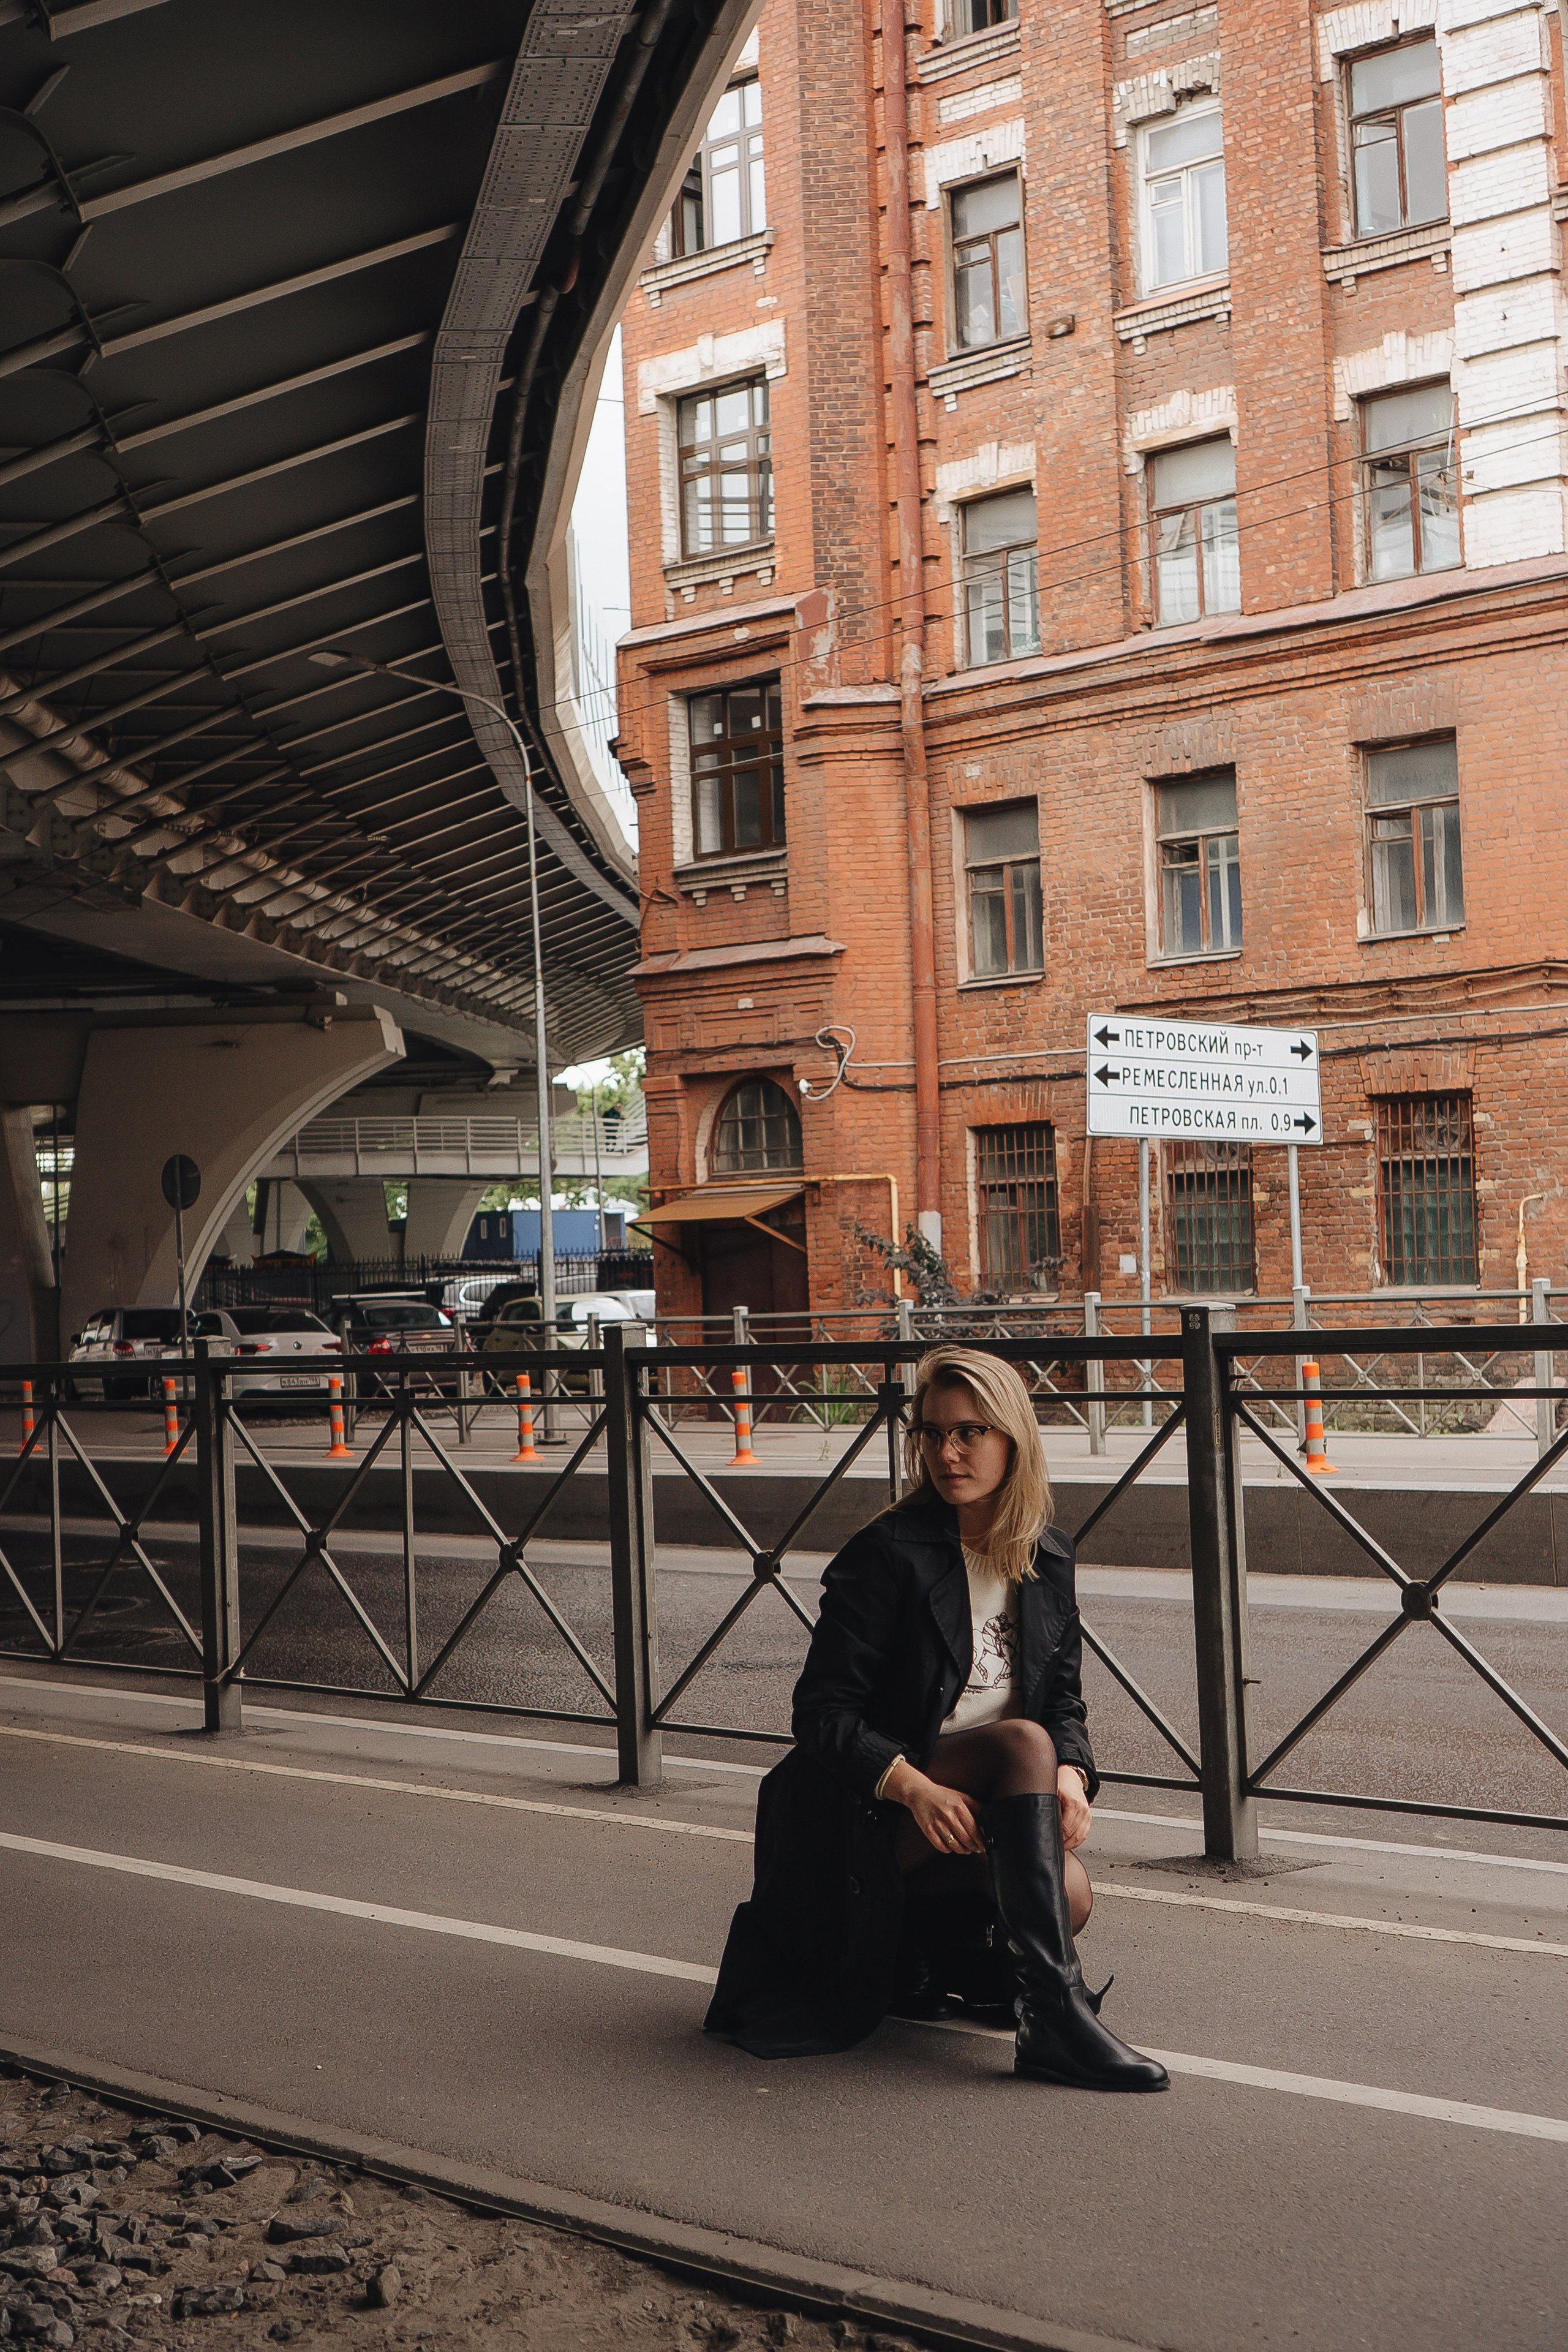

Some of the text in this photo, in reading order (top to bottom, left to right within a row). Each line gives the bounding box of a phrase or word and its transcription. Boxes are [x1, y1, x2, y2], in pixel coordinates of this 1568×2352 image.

[1125, 1029, 1263, 1060] ПЕТРОВСКИЙ пр-т
[1122, 1066, 1243, 1092] РЕМЕСЛЕННАЯ
[1129, 1106, 1291, 1133] ПЕТРОВСКАЯ пл. 0,9
